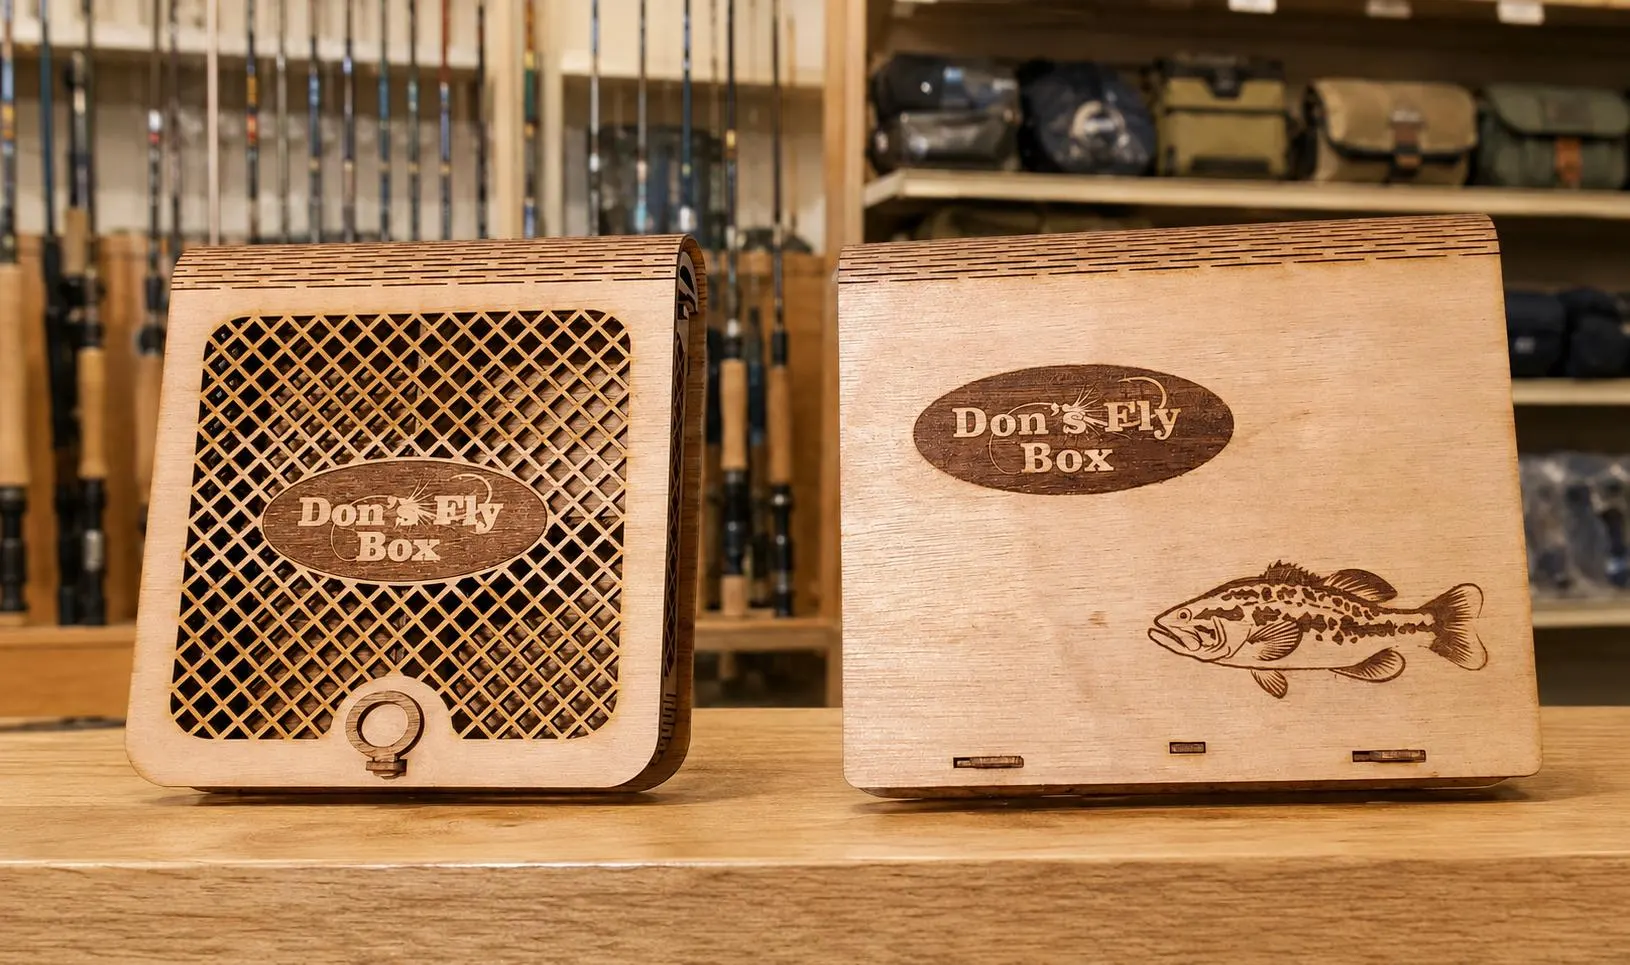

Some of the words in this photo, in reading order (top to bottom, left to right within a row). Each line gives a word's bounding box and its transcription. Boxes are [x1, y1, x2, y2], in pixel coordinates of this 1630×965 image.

[951, 402, 1087, 438] Don's
[1103, 400, 1182, 440] Fly
[1020, 442, 1114, 473] Box
[298, 495, 419, 527] Don's
[432, 495, 504, 534] Fly
[356, 531, 440, 561] Box
